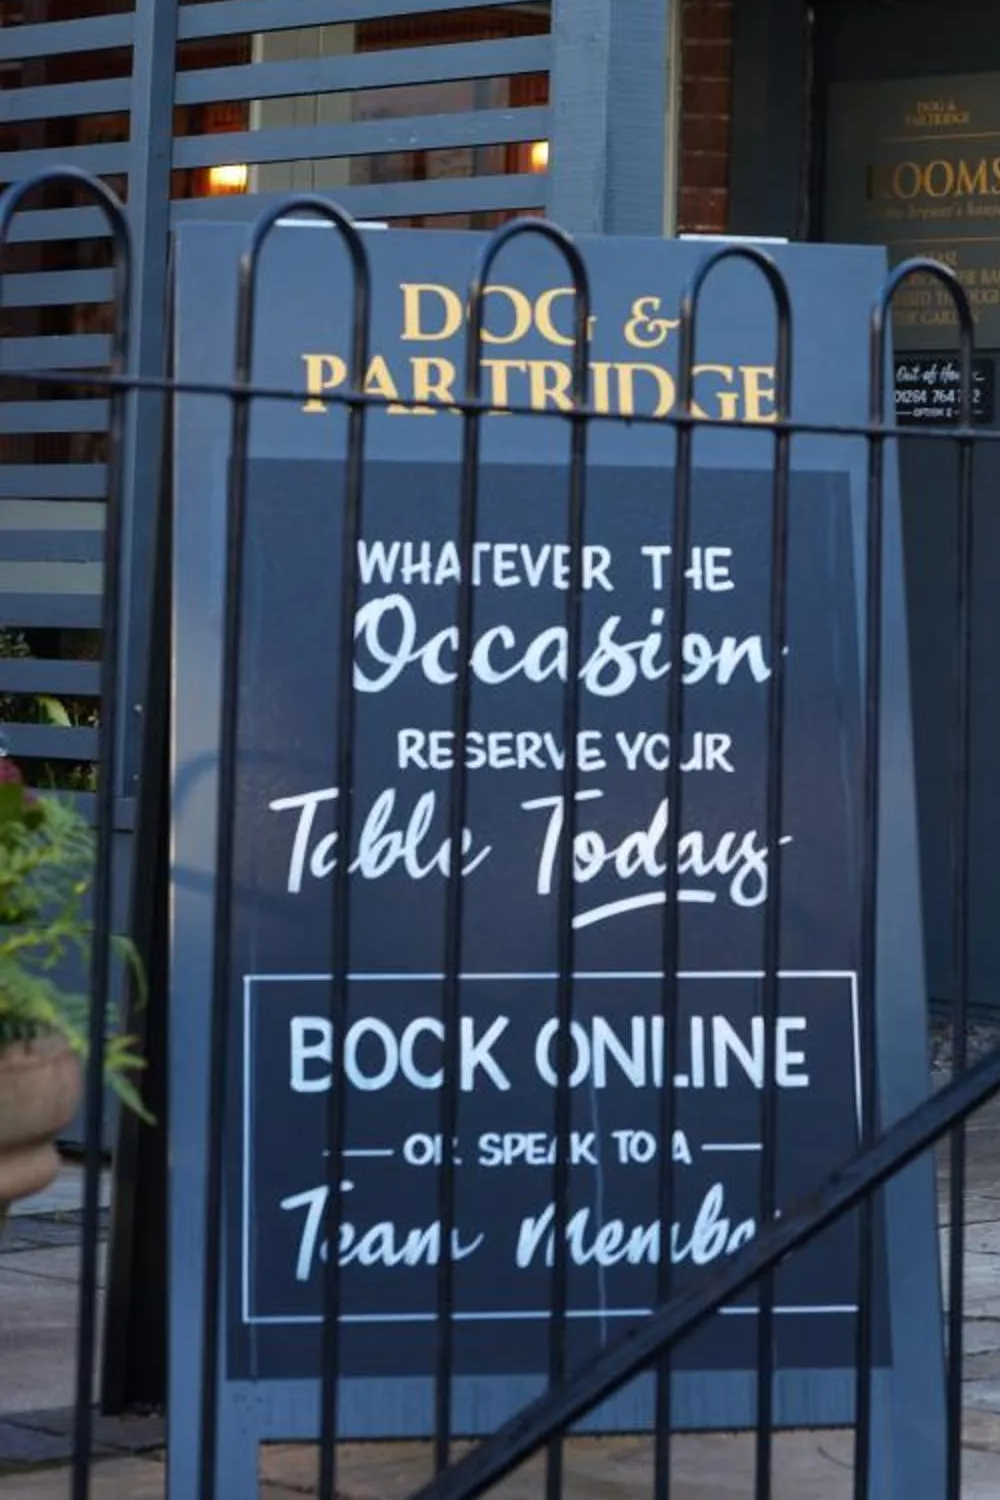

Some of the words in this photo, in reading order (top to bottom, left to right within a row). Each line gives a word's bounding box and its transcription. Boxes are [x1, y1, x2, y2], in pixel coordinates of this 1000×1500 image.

[400, 283, 597, 346] DOG
[624, 297, 681, 349] &
[301, 354, 778, 423] PARTRIDGE
[357, 540, 615, 592] WHATEVER
[353, 593, 772, 697] Occasion
[398, 730, 607, 770] RESERVE
[616, 731, 735, 772] YOUR
[521, 788, 792, 906] Today
[290, 1016, 511, 1092] BOOK
[535, 1015, 810, 1090] ONLINE
[611, 1130, 656, 1164] TO
[671, 1130, 693, 1165] A
[516, 1183, 783, 1268] Membe
